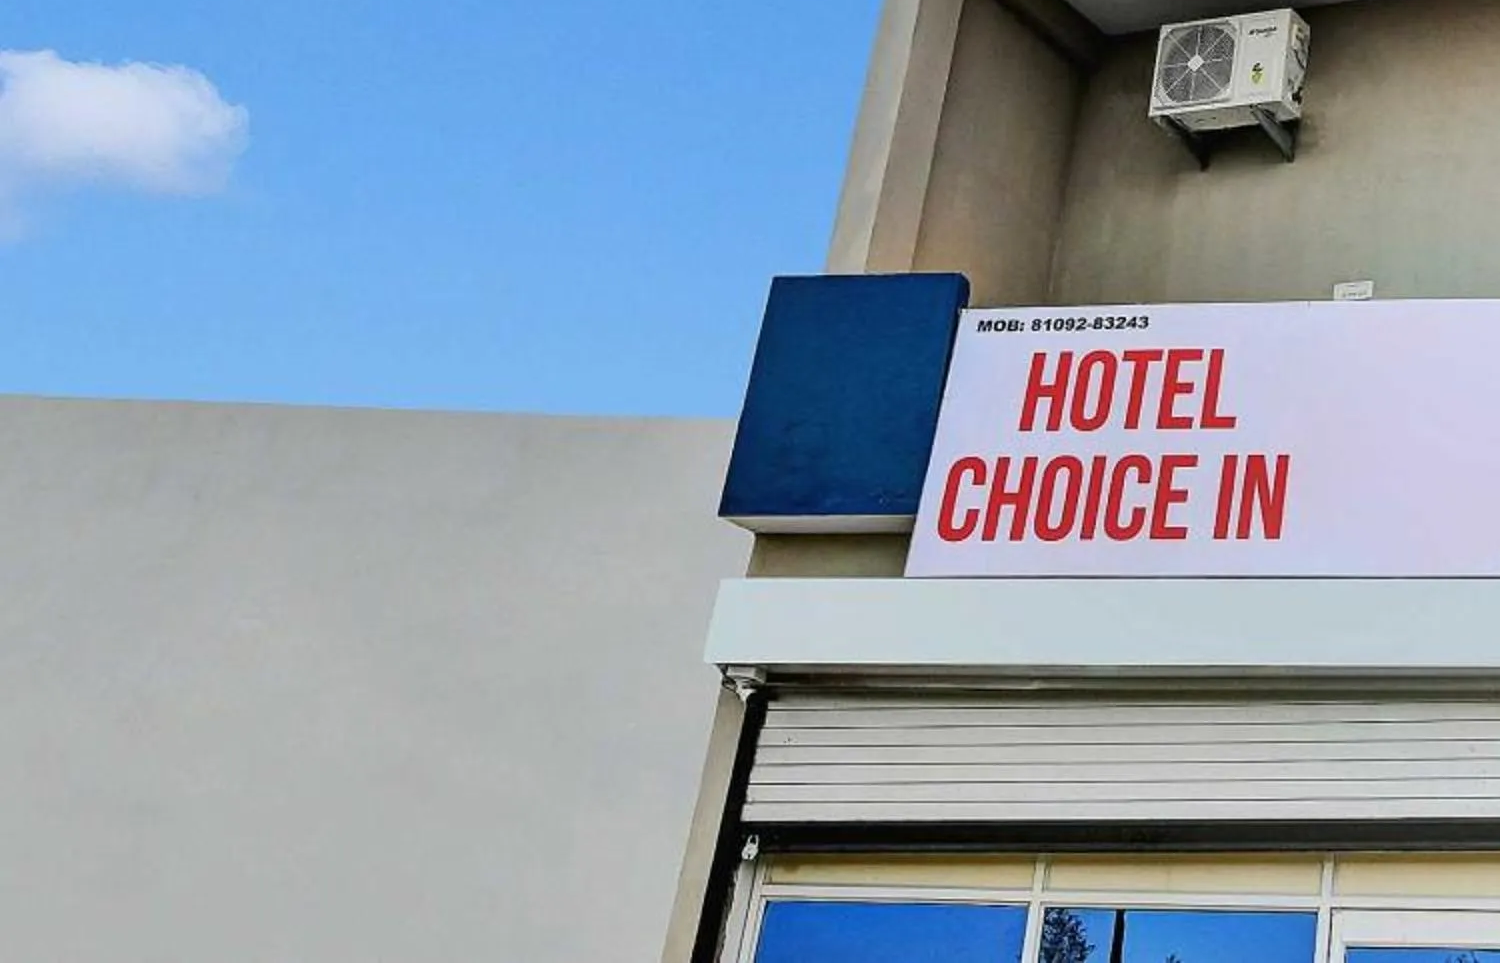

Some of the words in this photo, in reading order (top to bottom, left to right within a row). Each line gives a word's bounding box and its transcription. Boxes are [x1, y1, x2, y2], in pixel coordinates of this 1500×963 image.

[977, 319, 1025, 333] MOB:
[1031, 316, 1149, 332] 81092-83243
[1019, 349, 1235, 432] HOTEL
[938, 454, 1198, 542] CHOICE
[1213, 453, 1289, 540] IN
